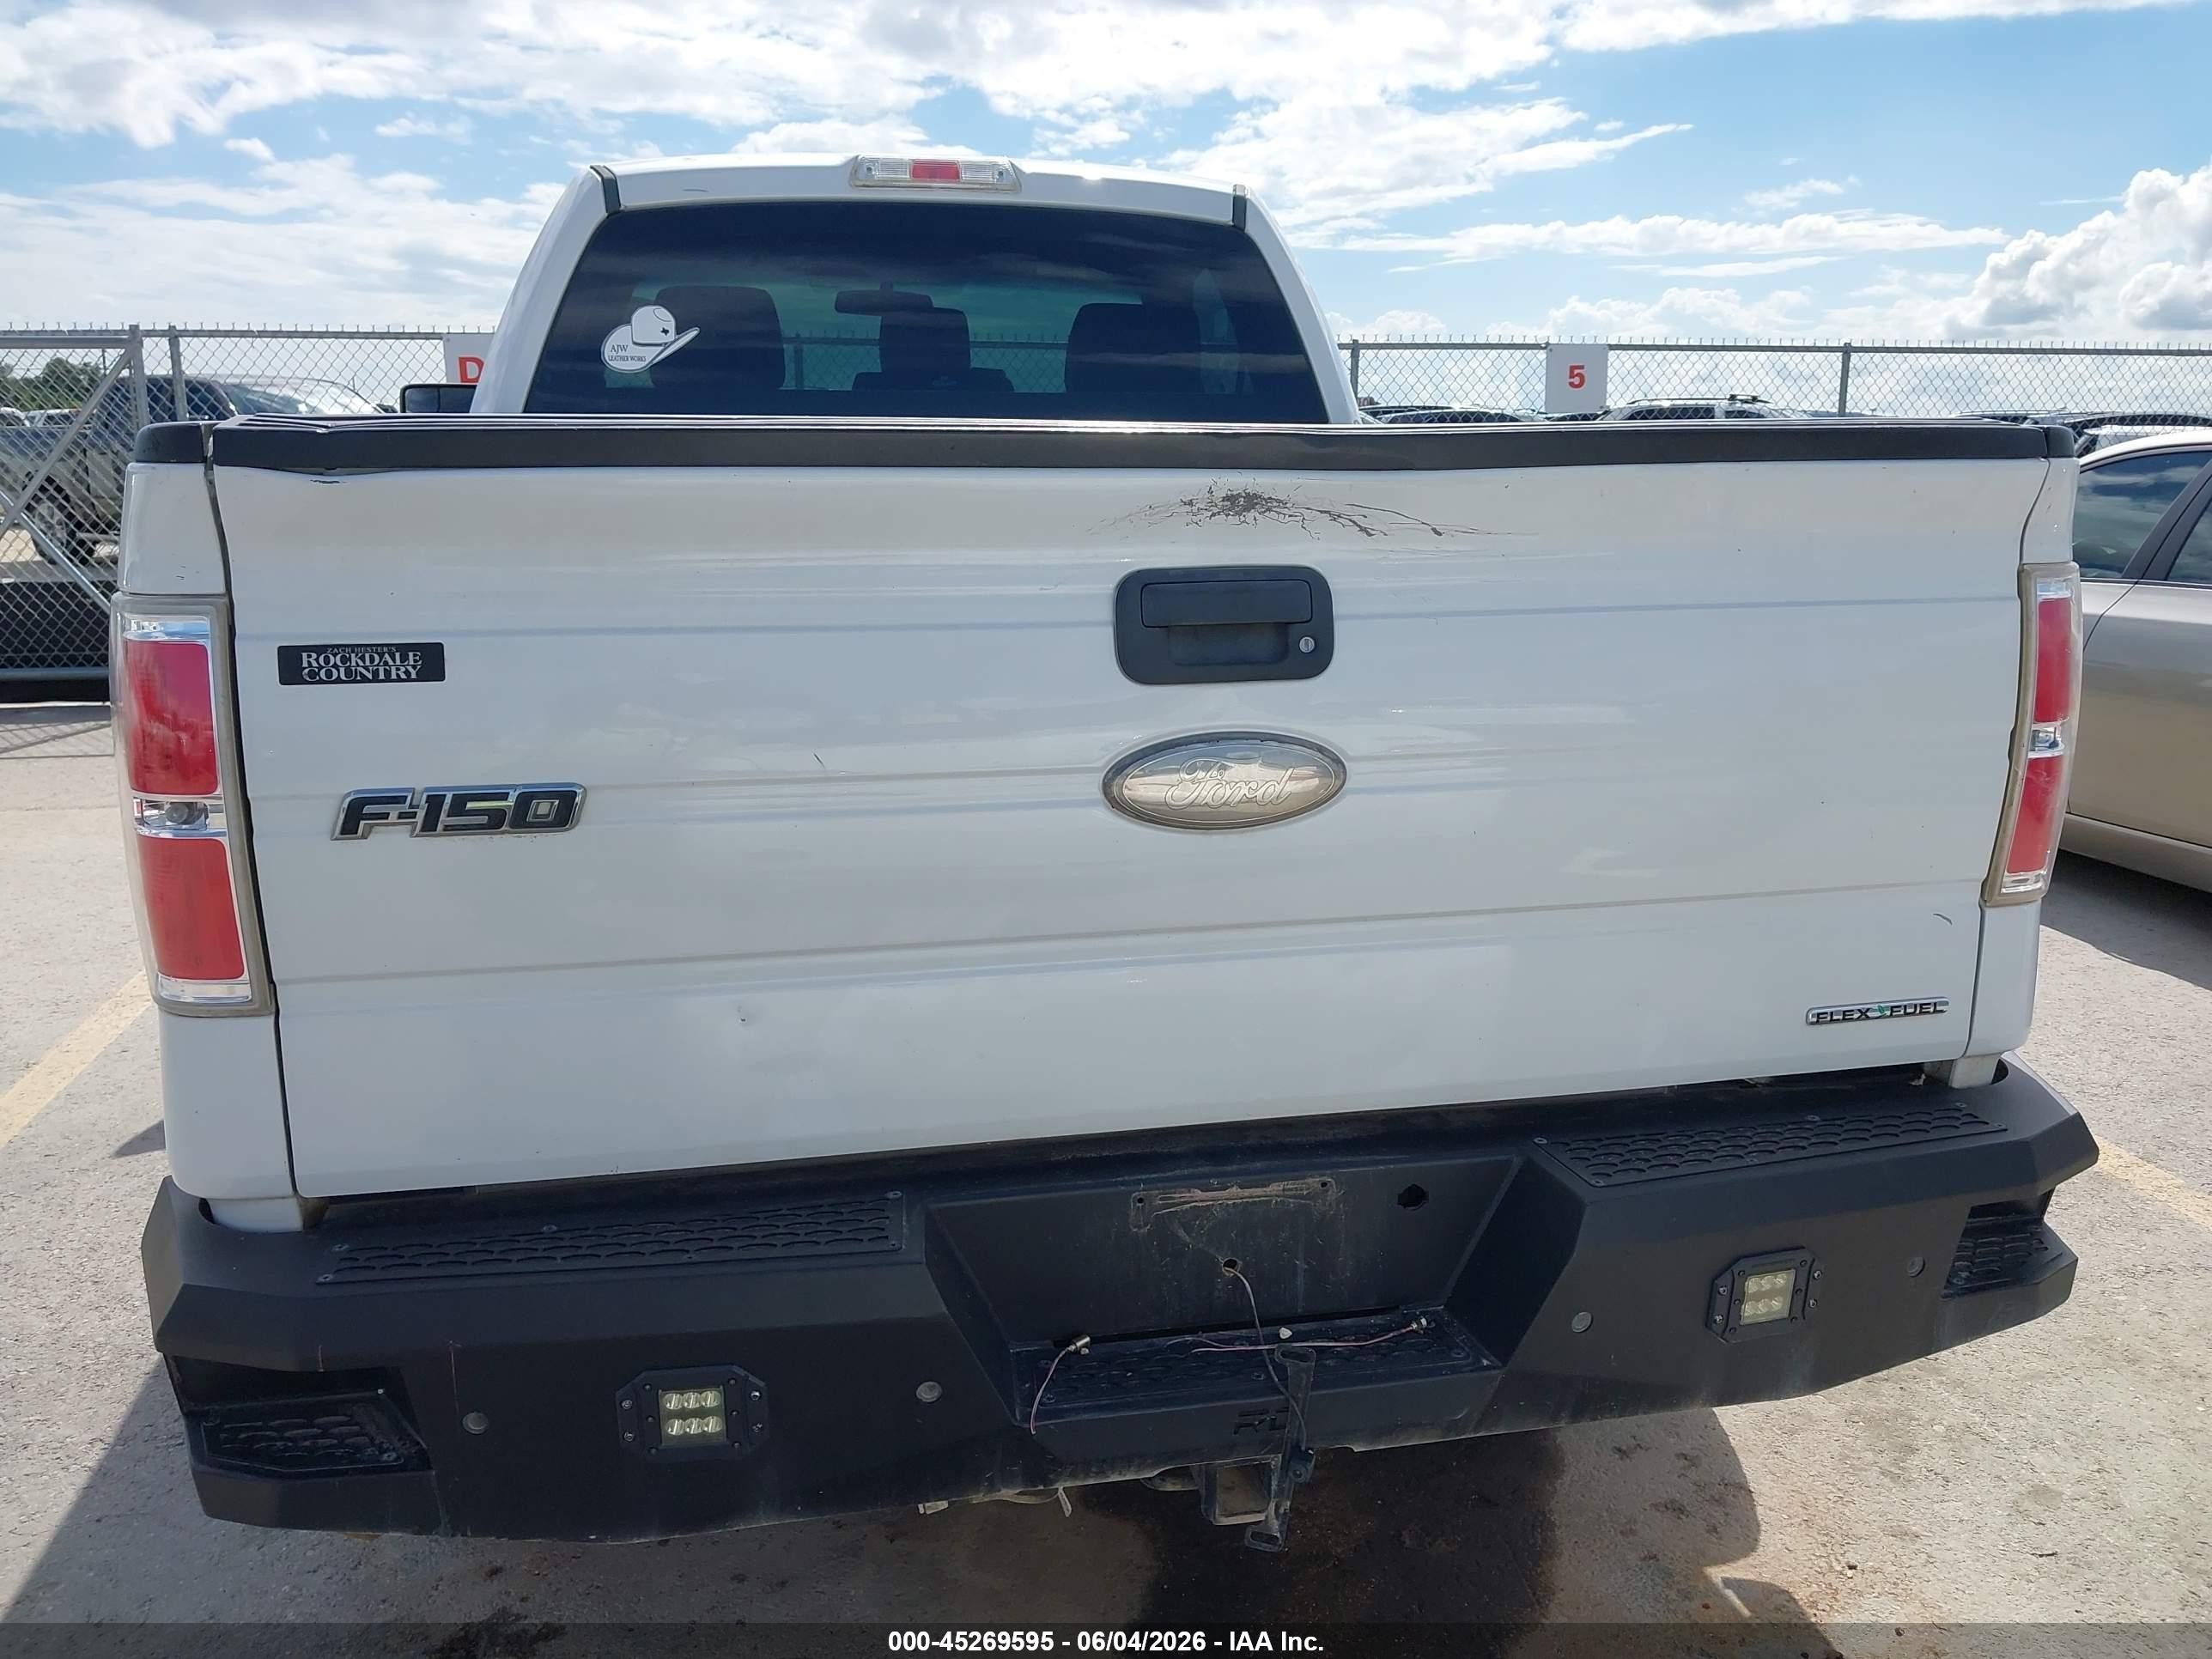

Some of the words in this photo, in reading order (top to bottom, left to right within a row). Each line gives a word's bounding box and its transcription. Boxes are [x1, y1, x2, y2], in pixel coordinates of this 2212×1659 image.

[611, 344, 629, 355] AJW
[1568, 365, 1585, 389] 5
[301, 652, 422, 667] ROCKDALE
[302, 665, 422, 681] COUNTRY
[1165, 757, 1294, 810] Ford
[331, 782, 586, 841] F-150
[1816, 1007, 1870, 1024] FLEX
[1889, 1001, 1947, 1017] FUEL
